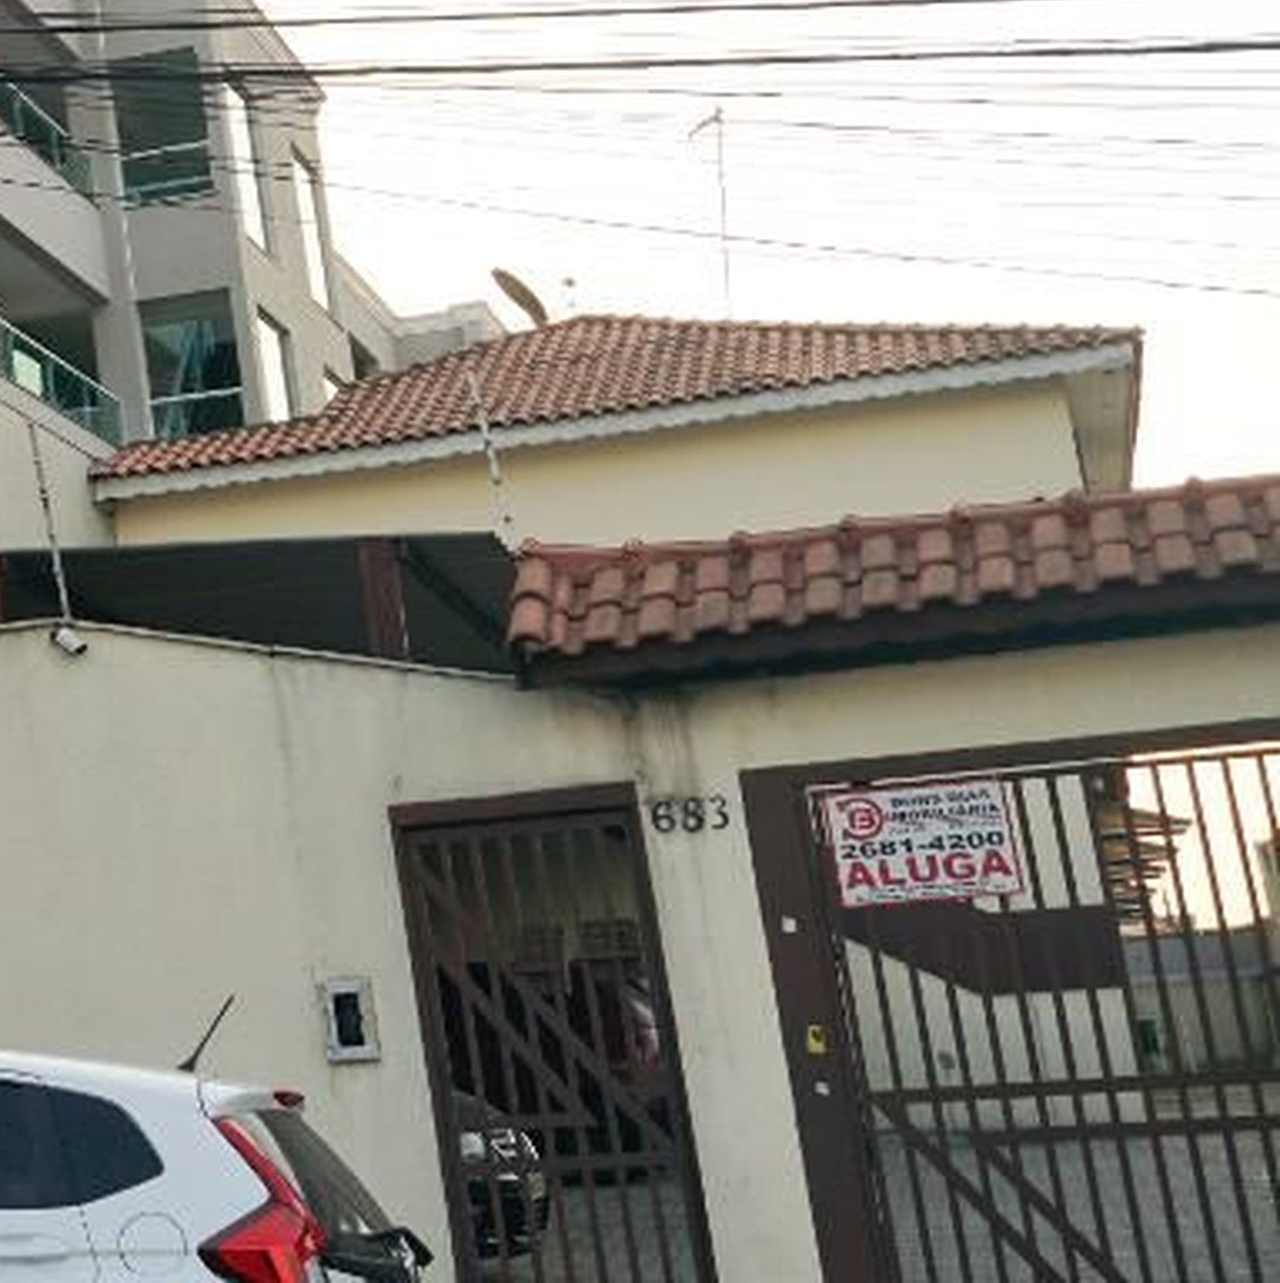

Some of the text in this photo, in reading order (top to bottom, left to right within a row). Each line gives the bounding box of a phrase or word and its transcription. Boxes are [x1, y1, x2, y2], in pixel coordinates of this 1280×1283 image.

[651, 794, 729, 833] 683
[840, 830, 1005, 860] 2681-4200
[846, 848, 1013, 890] ALUGA
